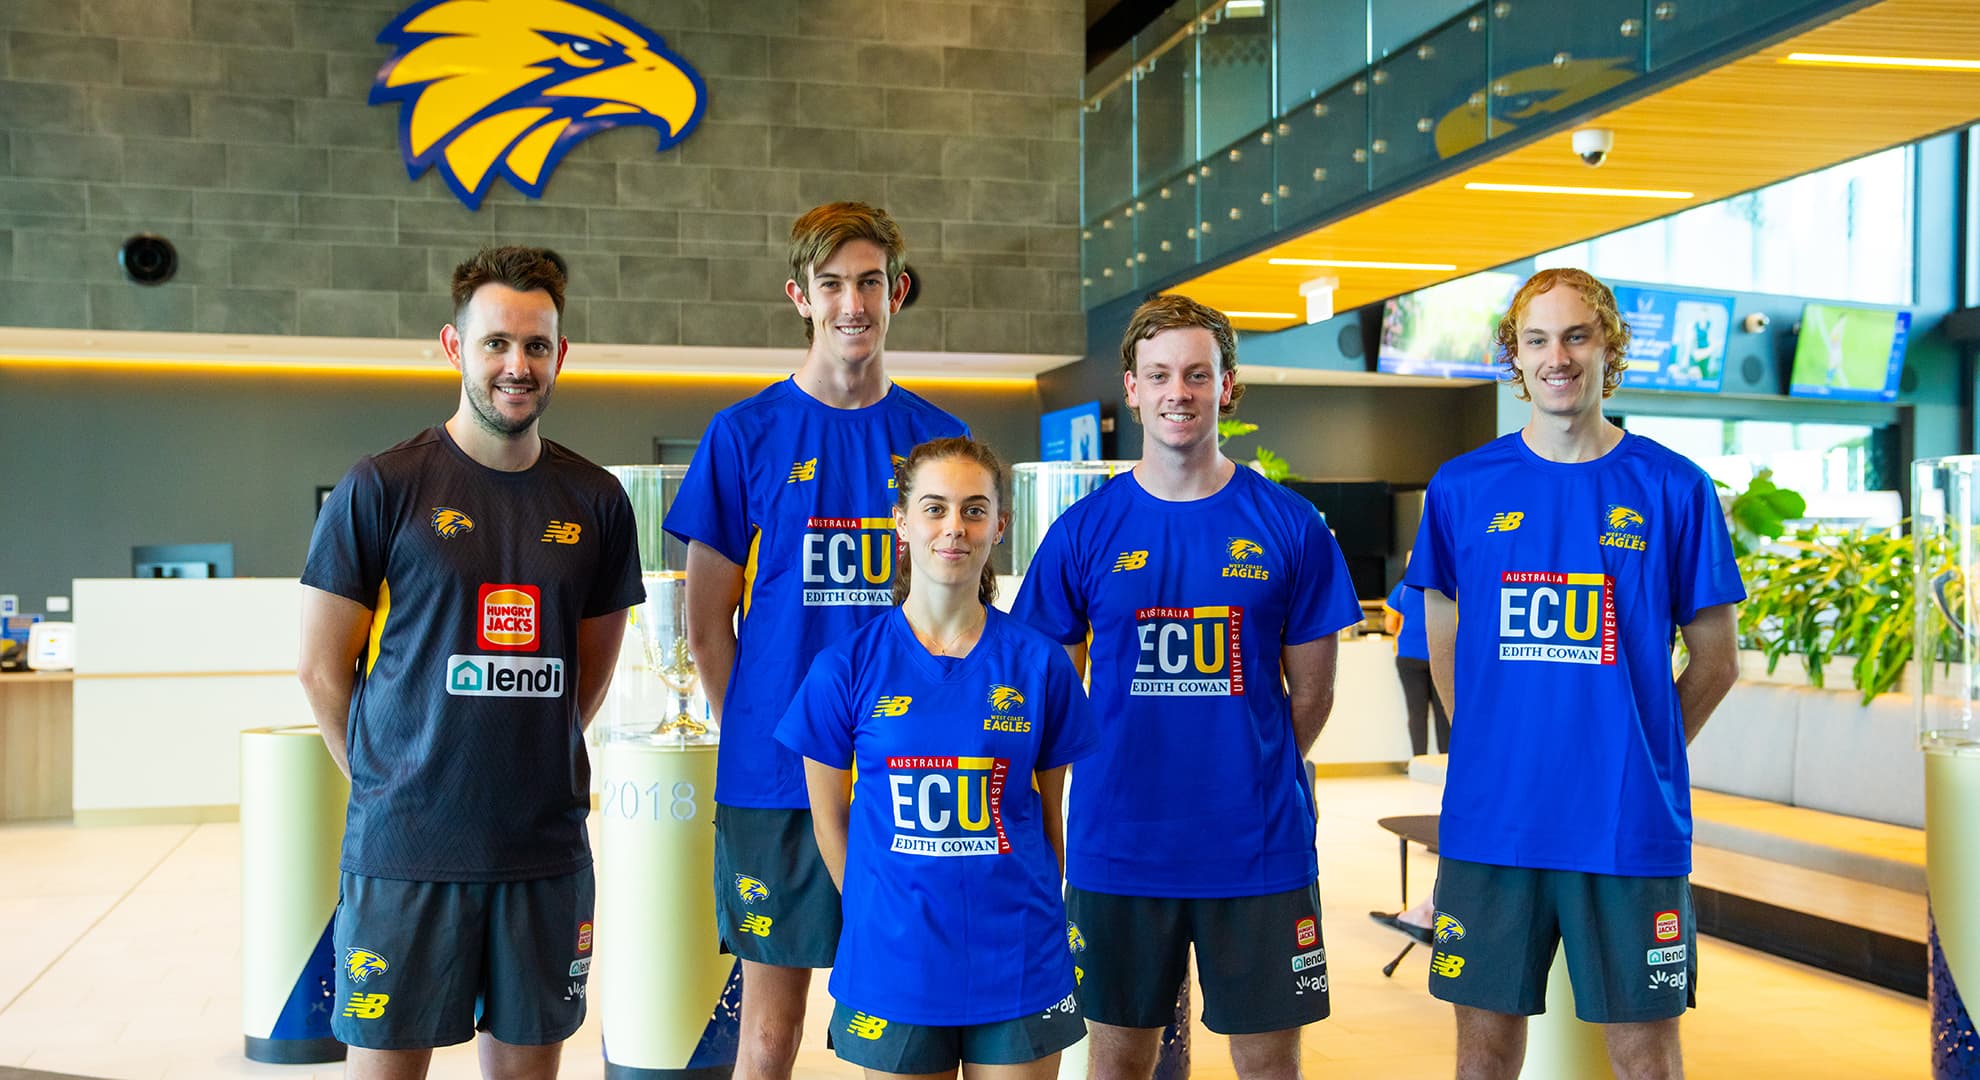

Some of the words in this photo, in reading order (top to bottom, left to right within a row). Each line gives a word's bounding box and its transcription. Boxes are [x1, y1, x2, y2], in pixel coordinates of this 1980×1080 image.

[807, 518, 857, 529] AUSTRALIA
[1599, 535, 1647, 551] EAGLES
[803, 533, 891, 584] ECU
[1222, 567, 1269, 580] EAGLES
[1506, 573, 1563, 583] AUSTRALIA
[805, 591, 845, 602] EDITH
[487, 605, 532, 617] HUNGRY
[1500, 587, 1599, 641] ECU
[1604, 579, 1616, 662] UNIVERSITY
[1135, 623, 1225, 674] ECU
[1232, 610, 1244, 692] UNIVERSITY
[1502, 646, 1542, 657] EDITH
[1547, 647, 1599, 661] COWAN
[487, 662, 561, 693] lendi
[1132, 681, 1174, 692] EDITH
[1178, 681, 1228, 693] COWAN
[983, 719, 1031, 732] EAGLES
[890, 758, 953, 768] AUSTRALIA
[604, 780, 697, 821] 2018
[889, 774, 990, 831] ECU
[991, 763, 1009, 850] UNIVERSITY
[895, 837, 936, 852] EDITH
[941, 839, 997, 853] COWAN
